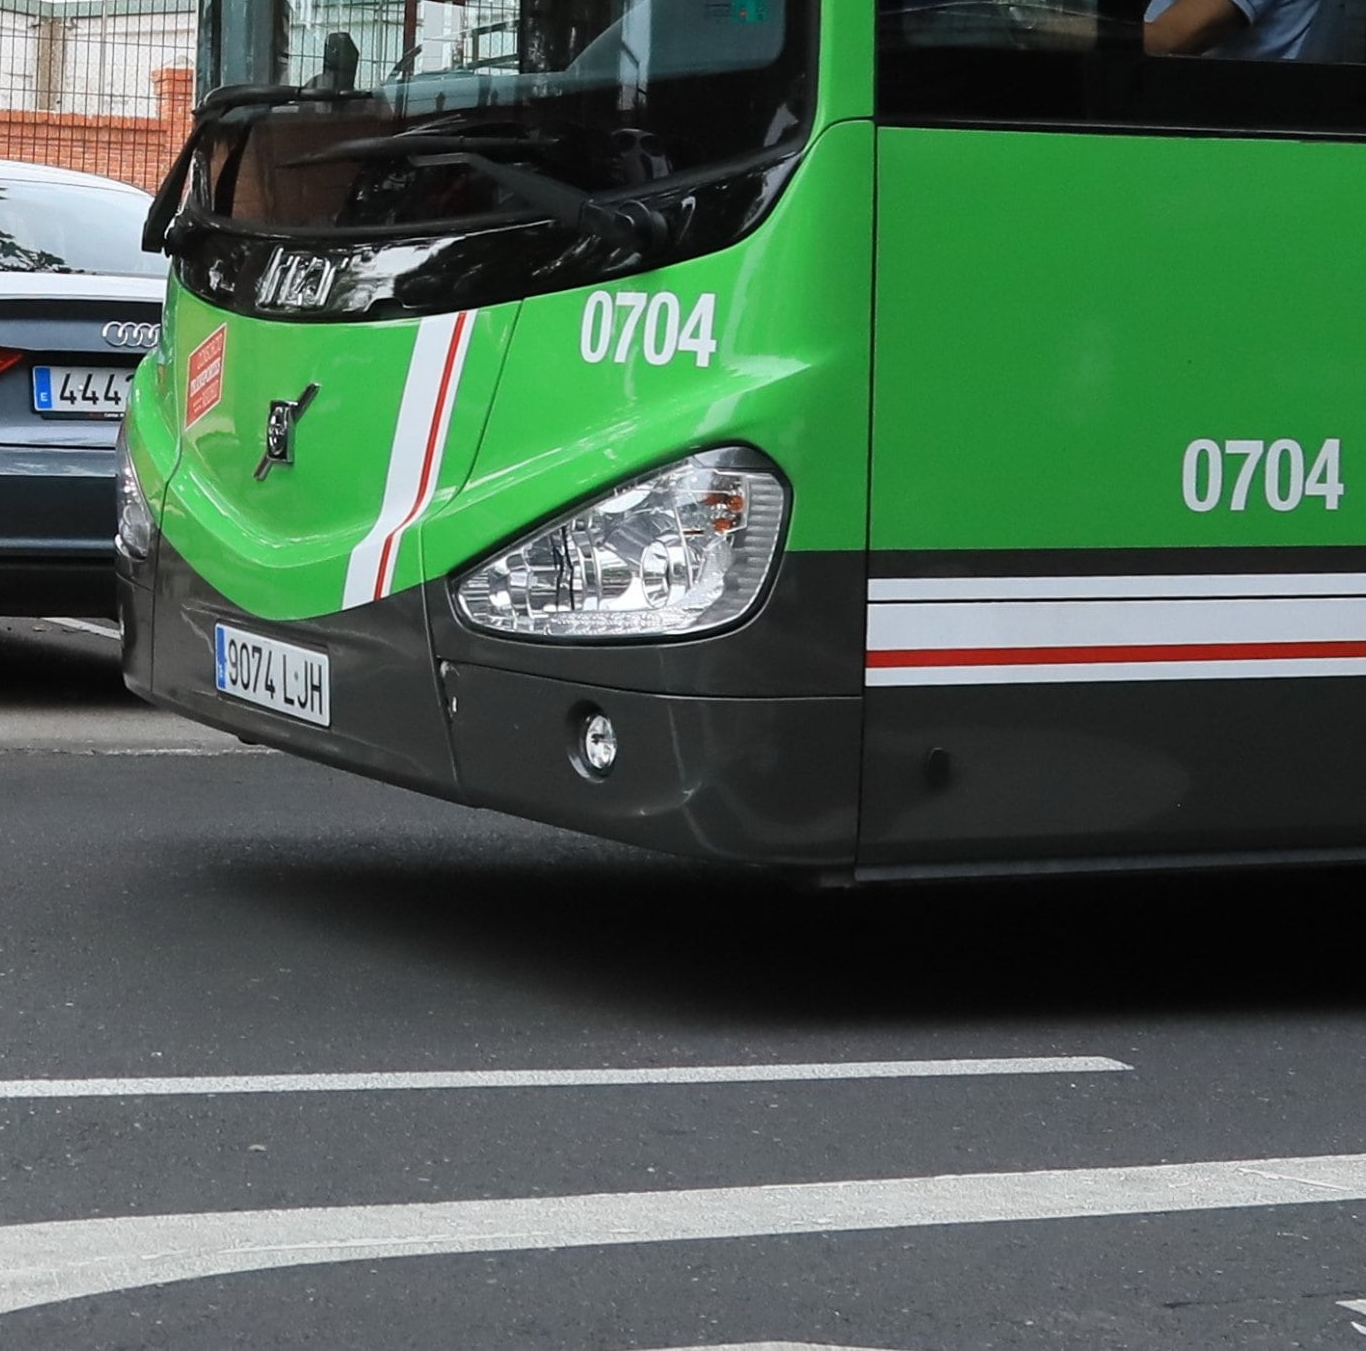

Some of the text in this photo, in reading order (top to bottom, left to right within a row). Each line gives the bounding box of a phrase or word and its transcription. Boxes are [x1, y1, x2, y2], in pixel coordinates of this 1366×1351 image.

[580, 290, 717, 367] 0704
[59, 373, 135, 406] 444
[1182, 438, 1345, 512] 0704
[228, 639, 323, 715] 9074 LJH
